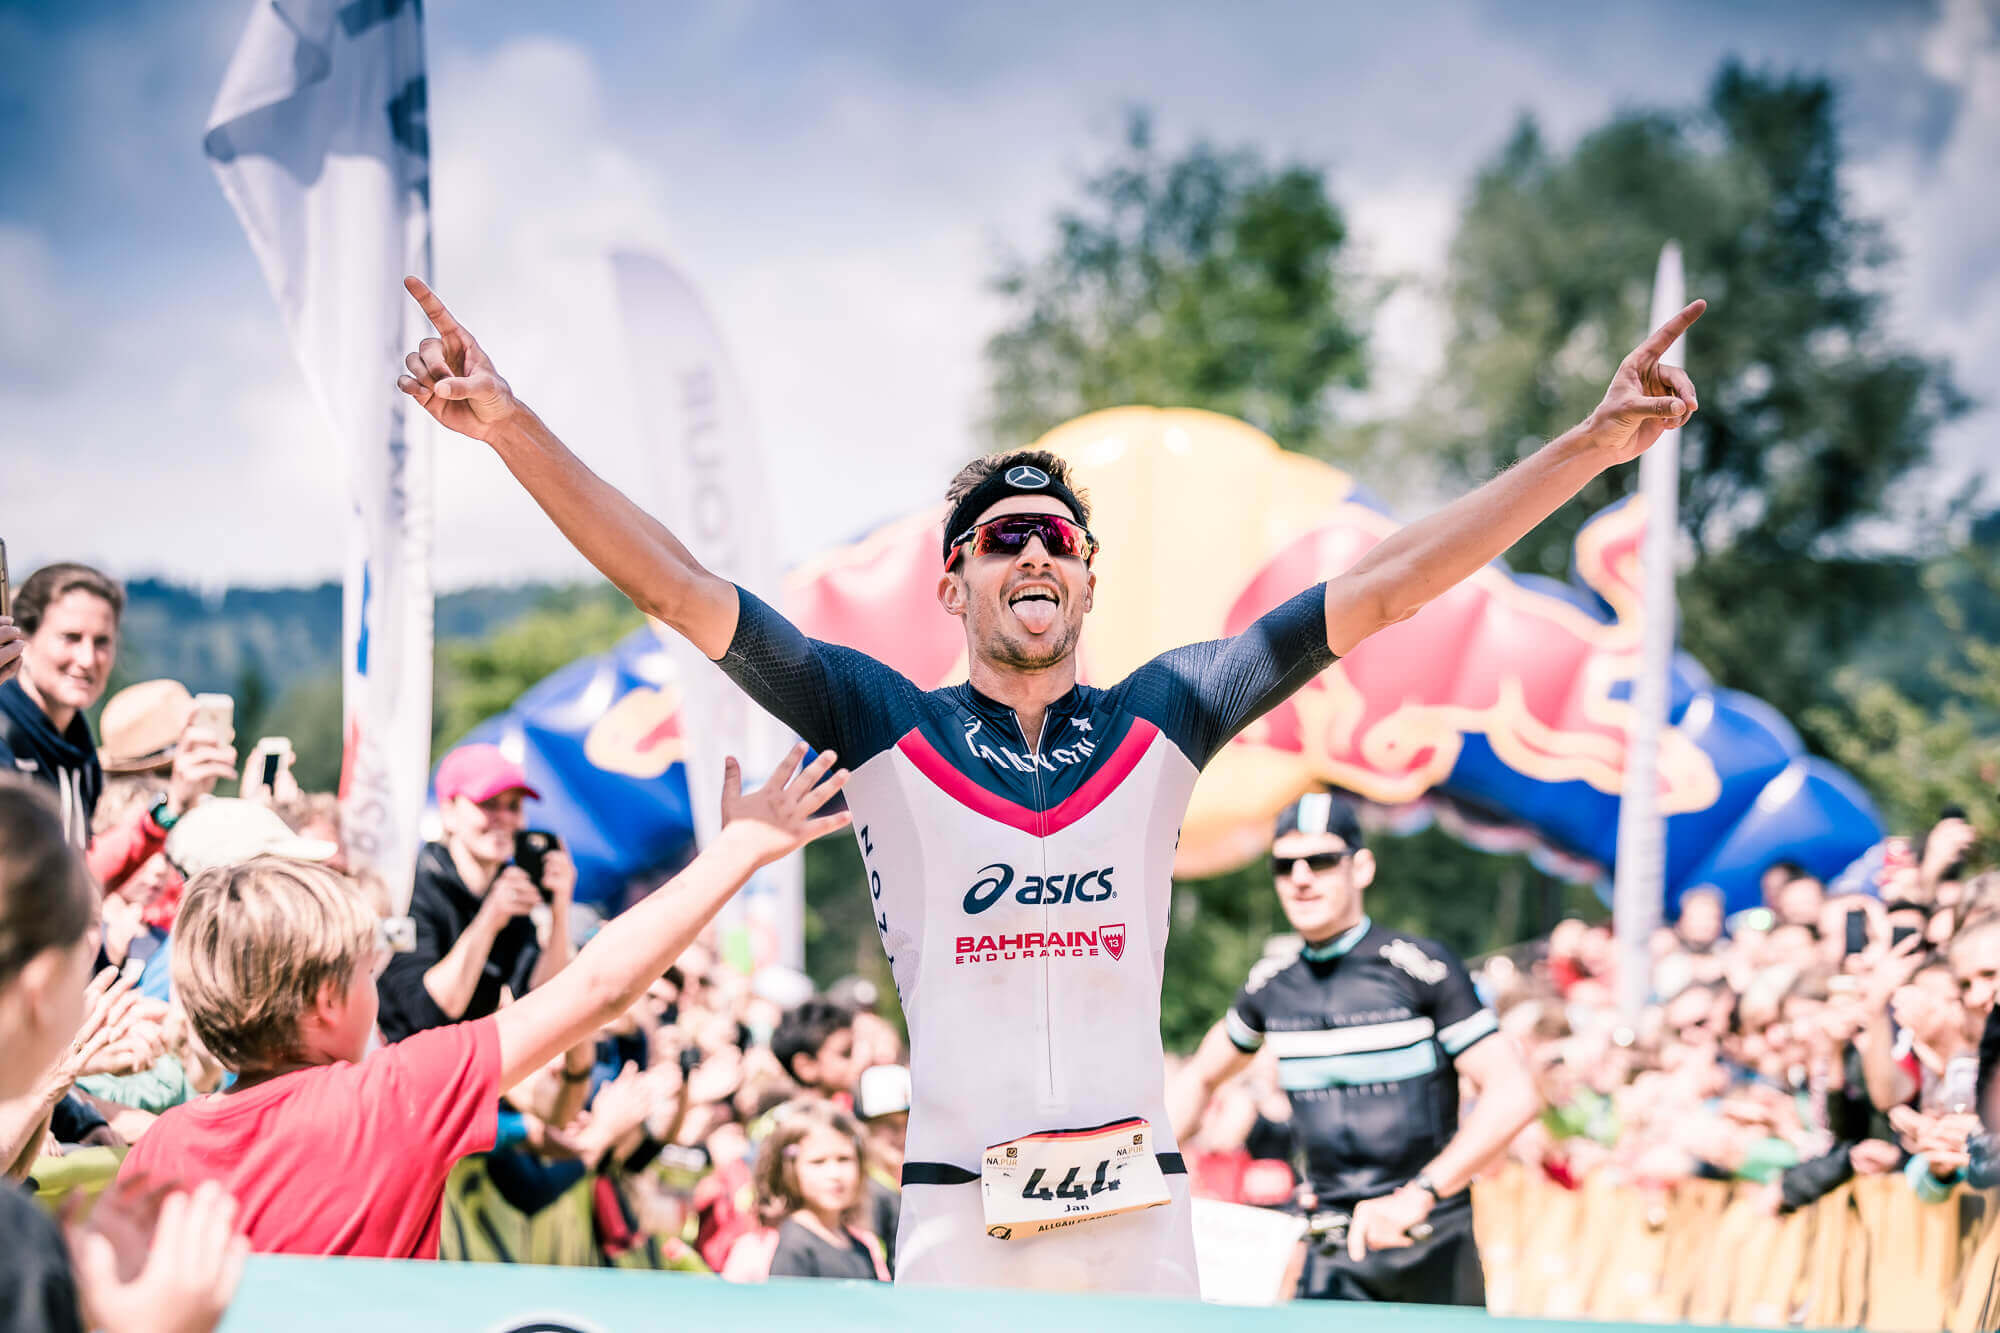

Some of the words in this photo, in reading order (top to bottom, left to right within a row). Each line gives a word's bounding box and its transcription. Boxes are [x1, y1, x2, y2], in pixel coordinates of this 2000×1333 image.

[956, 931, 1098, 953] BAHRAIN
[955, 948, 1099, 964] ENDURANCE
[986, 1157, 999, 1166] NA
[1022, 1160, 1120, 1200] 444
[1064, 1203, 1089, 1213] Jan
